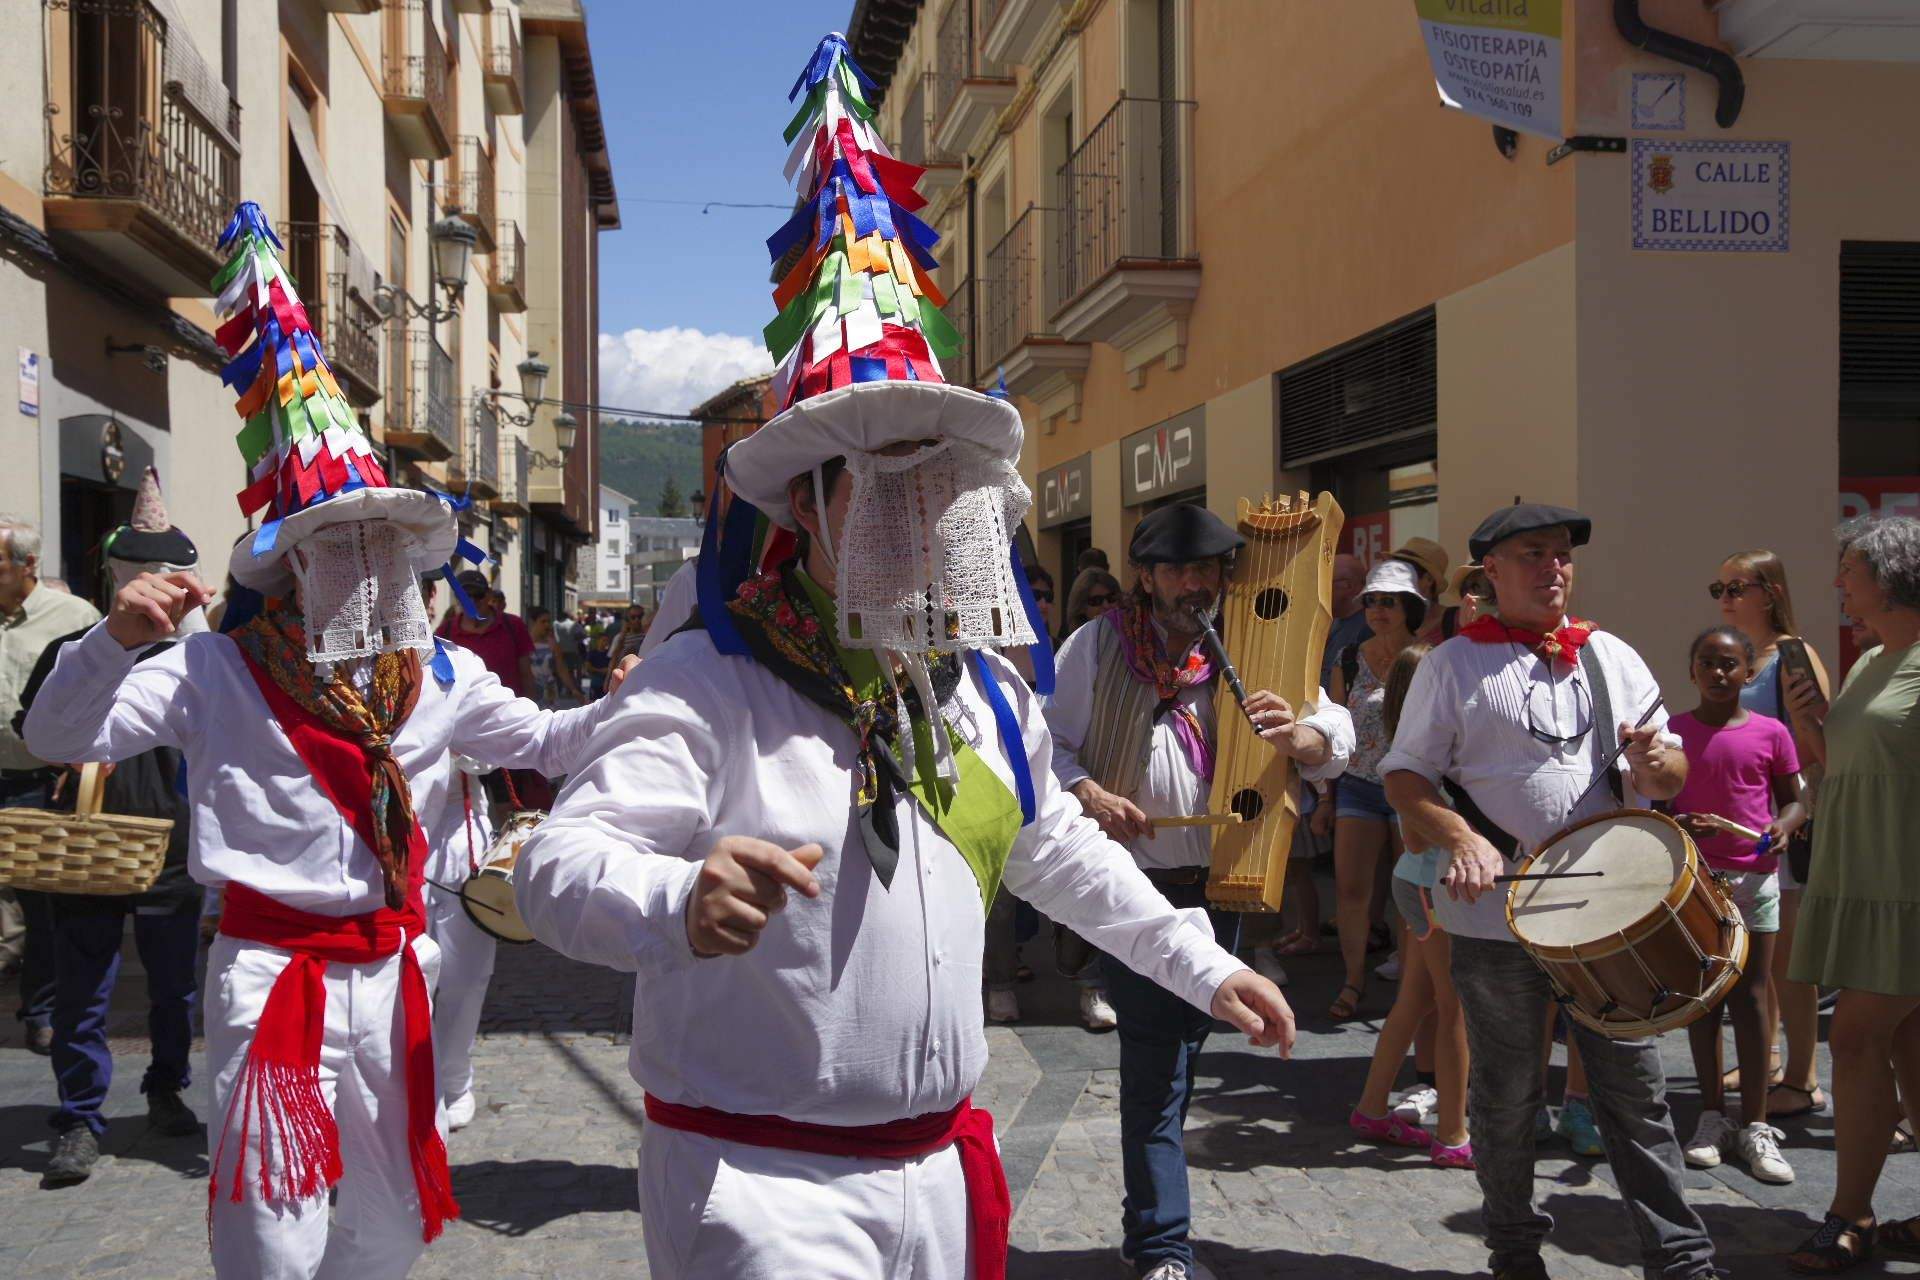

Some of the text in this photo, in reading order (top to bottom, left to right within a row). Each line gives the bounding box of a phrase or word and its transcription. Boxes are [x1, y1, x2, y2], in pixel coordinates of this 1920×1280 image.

[1432, 26, 1548, 58] FISIOTERAPIA
[1443, 50, 1541, 84] OSTEOPATÍA
[1463, 86, 1486, 103] 974
[1509, 102, 1533, 117] 709
[1695, 162, 1770, 184] CALLE
[1652, 208, 1770, 236] BELLIDO
[1134, 427, 1192, 493] CMP
[1045, 469, 1081, 519] CMP
